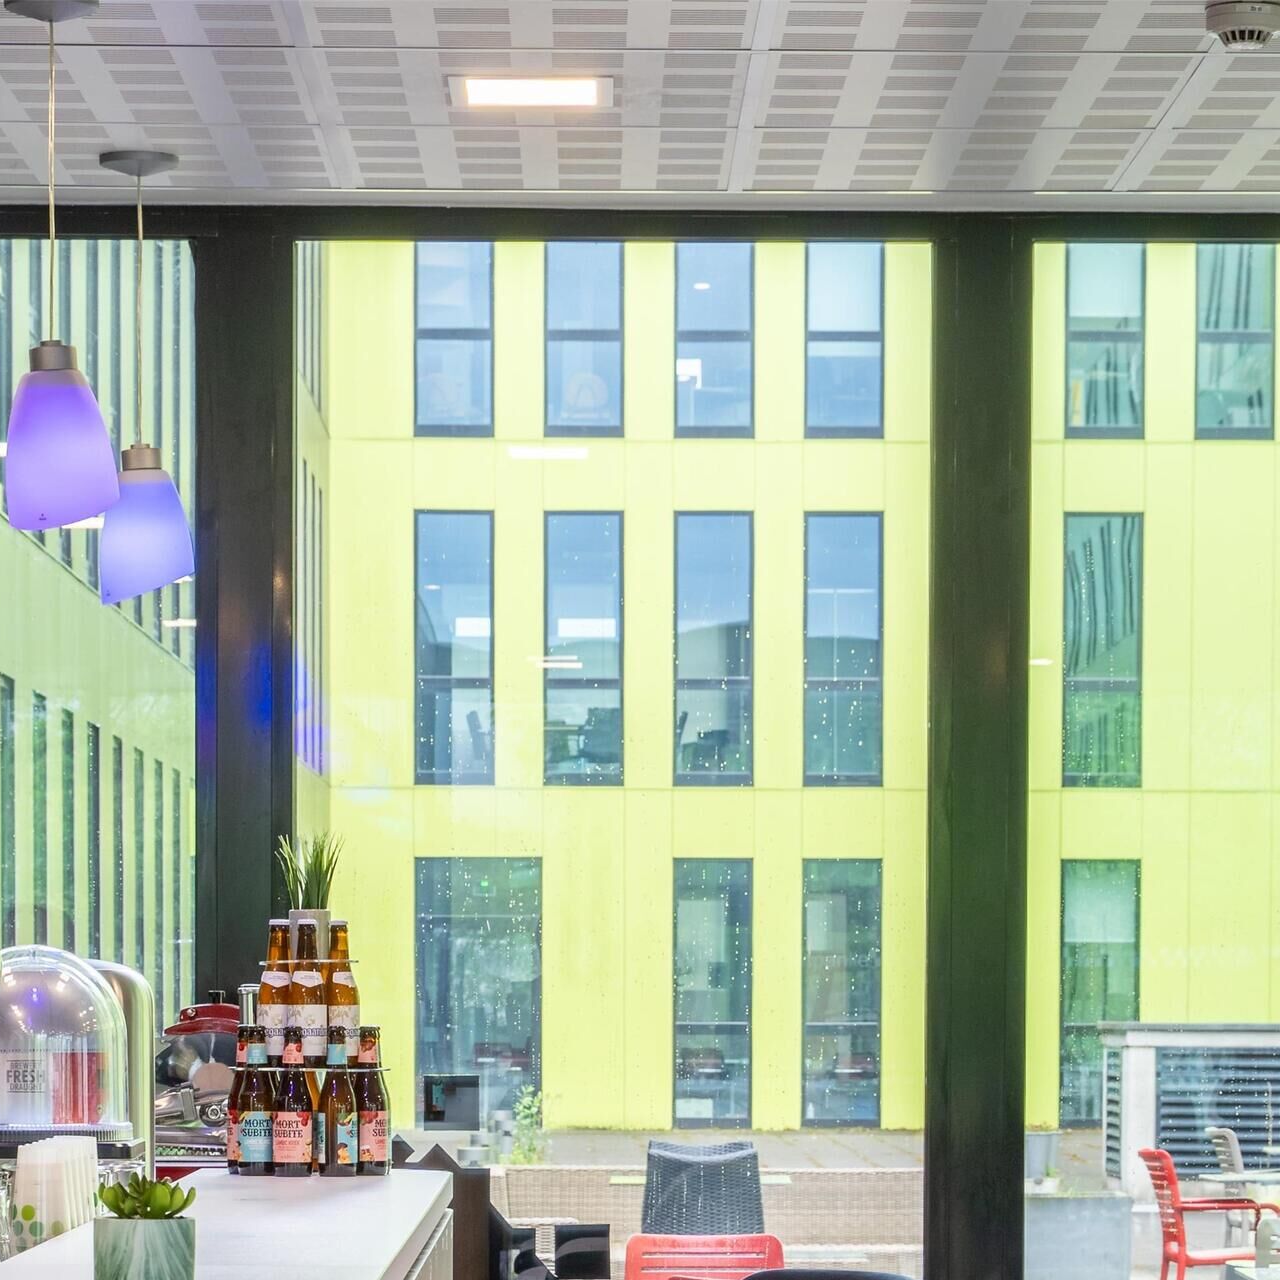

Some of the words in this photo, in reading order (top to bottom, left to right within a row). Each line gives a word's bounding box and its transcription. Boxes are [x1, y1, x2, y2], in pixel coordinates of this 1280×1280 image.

[6, 1070, 46, 1083] FRESH
[244, 1119, 270, 1128] MORT
[275, 1120, 300, 1129] MORT
